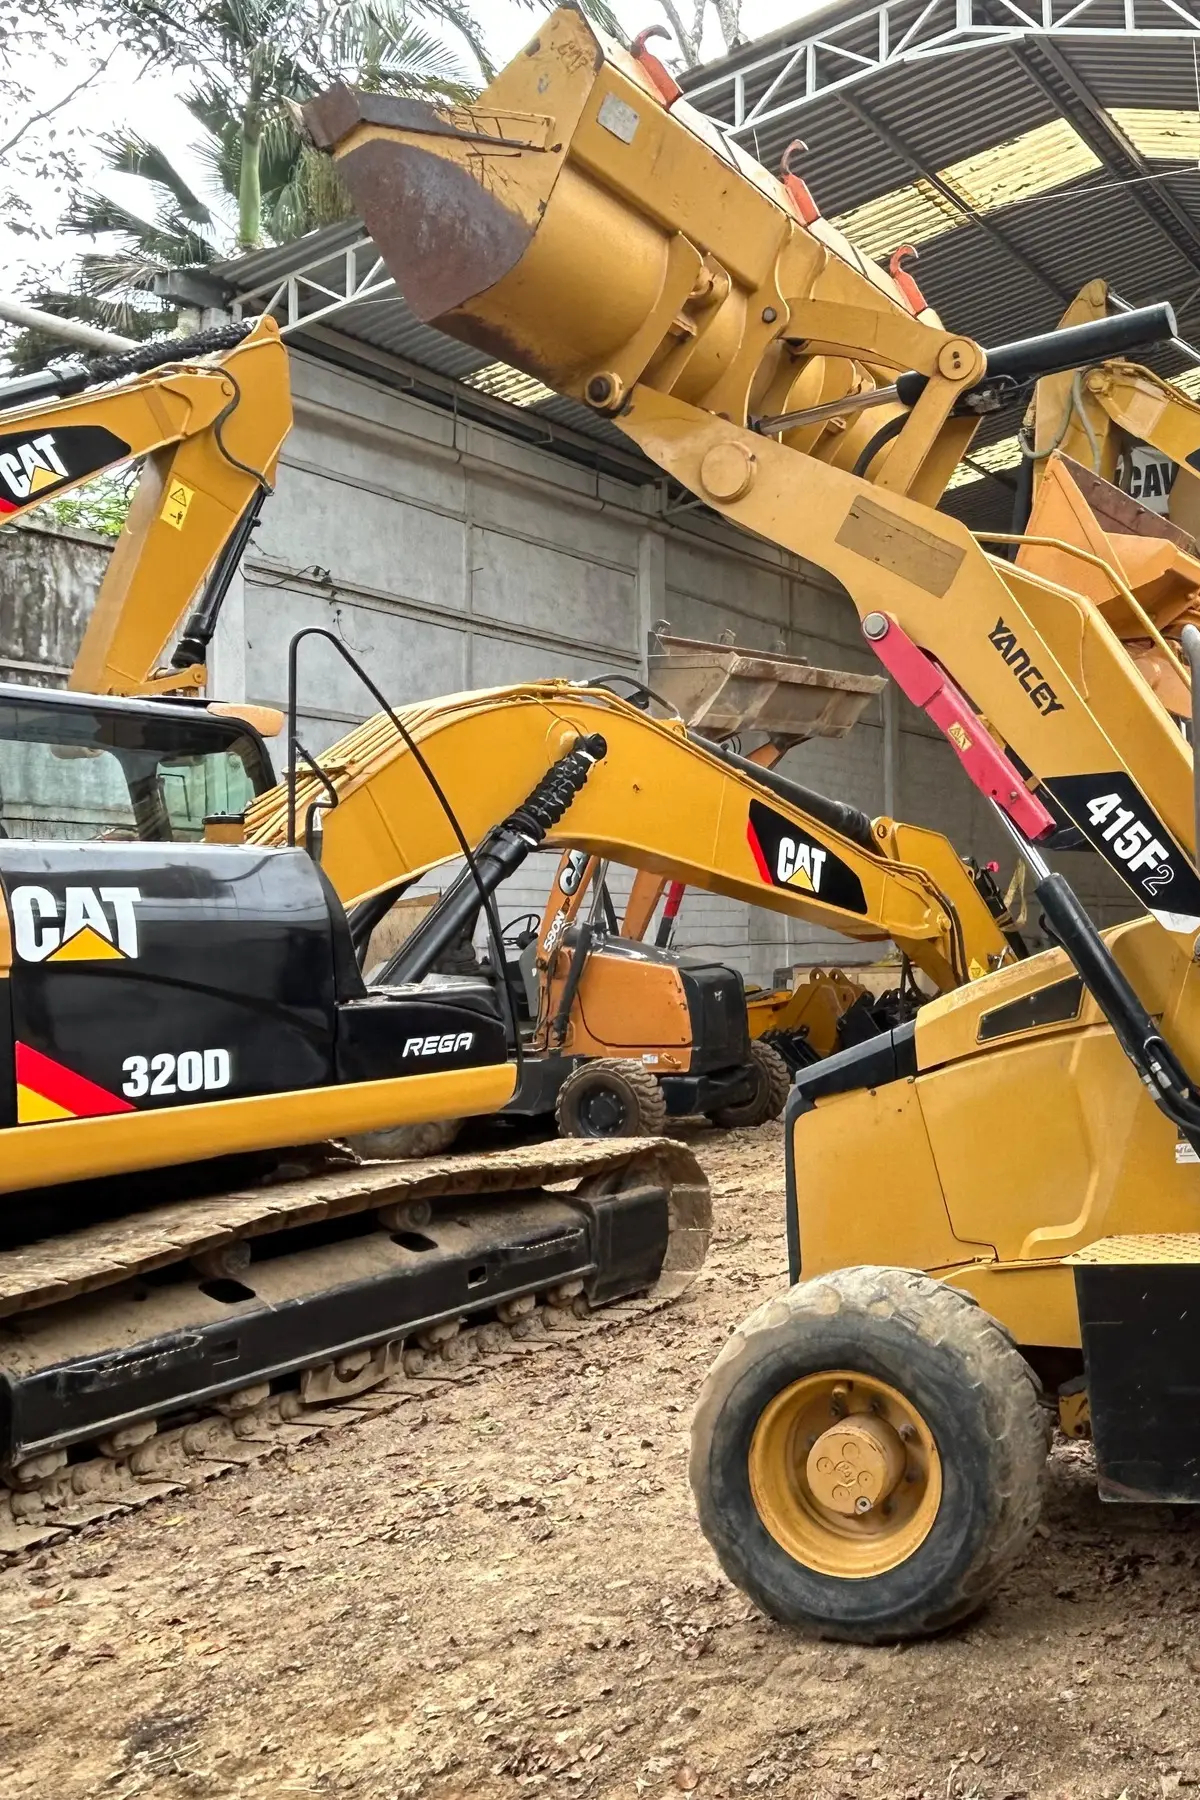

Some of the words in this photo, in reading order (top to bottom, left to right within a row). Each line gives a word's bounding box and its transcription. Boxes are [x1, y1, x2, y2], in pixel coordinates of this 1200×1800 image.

[0, 433, 69, 498] CAT
[988, 617, 1065, 717] YANCEY
[777, 837, 826, 893] CAT
[1085, 792, 1174, 896] 415F2
[11, 885, 142, 963] CAT
[122, 1048, 230, 1098] 320D
[402, 1032, 473, 1058] REGA
